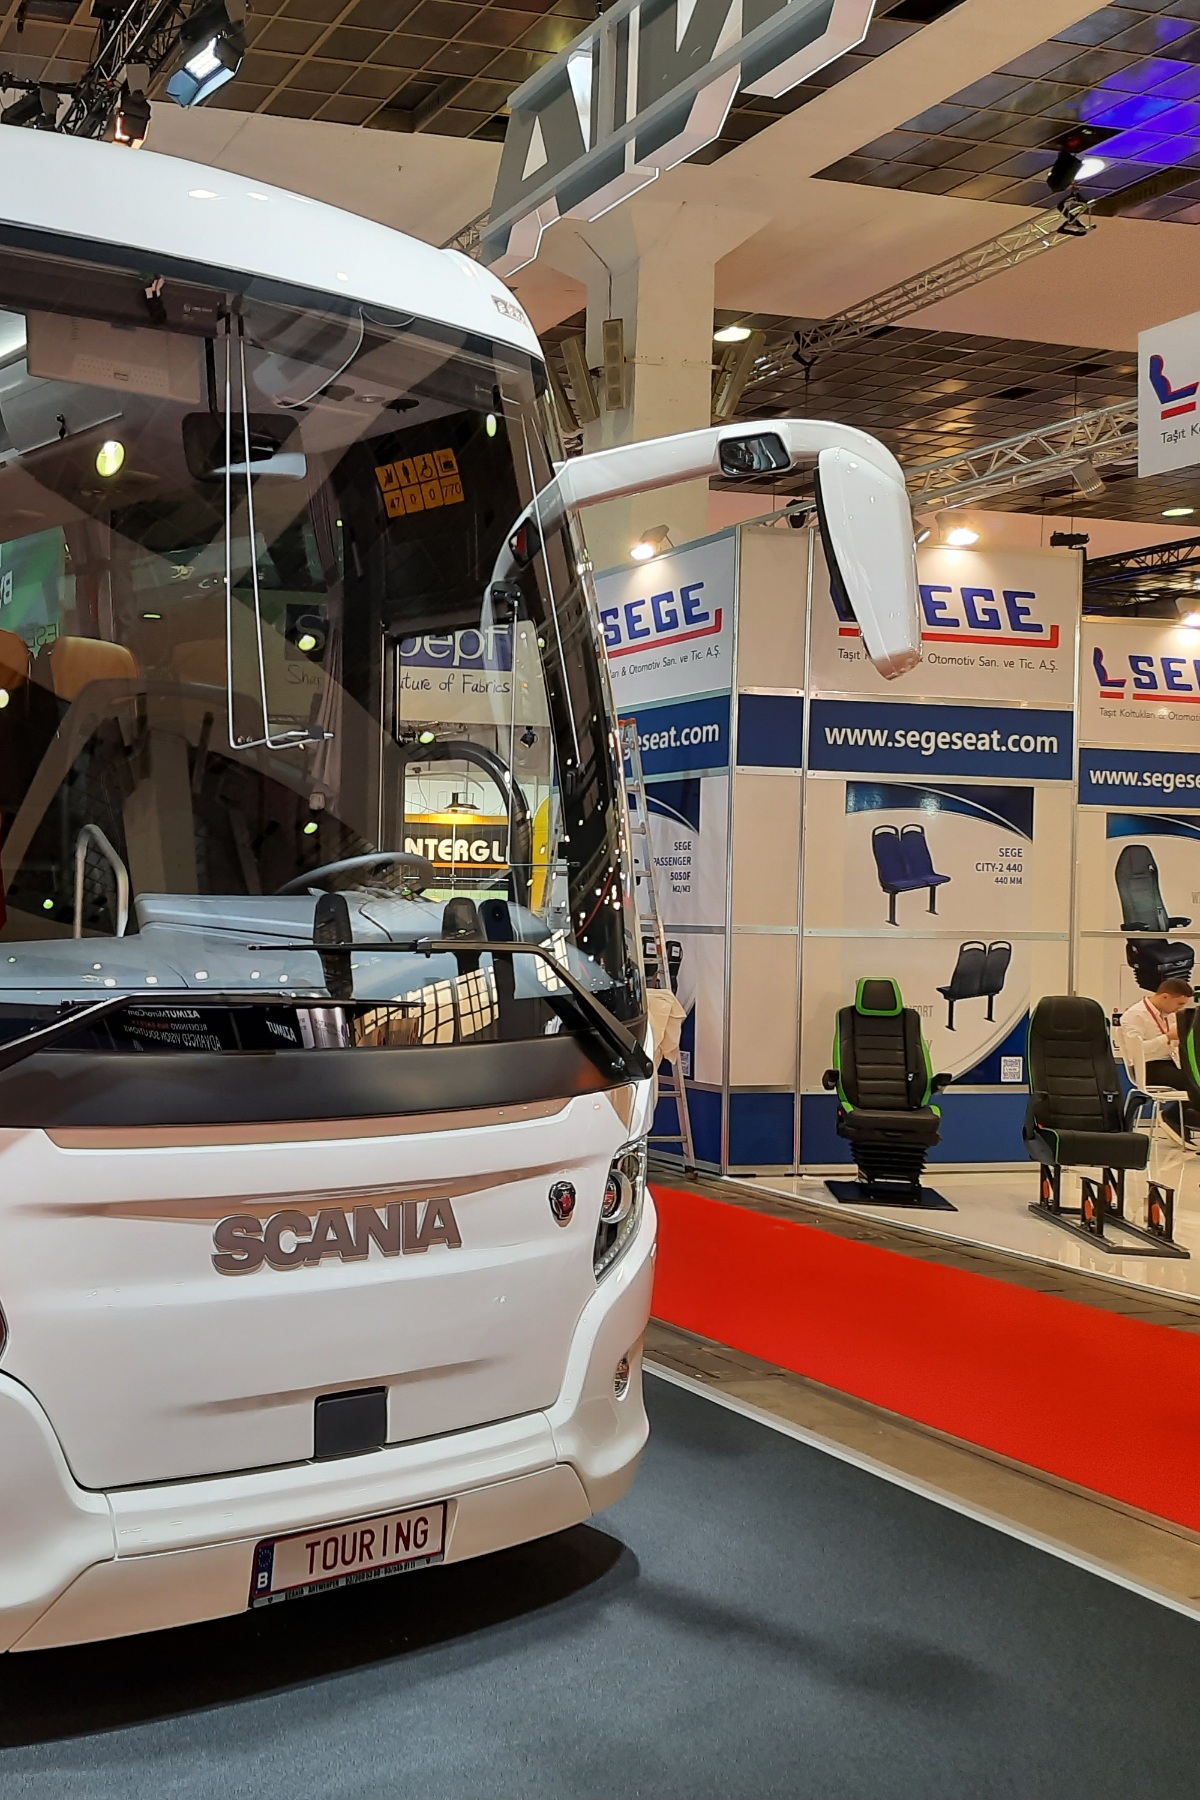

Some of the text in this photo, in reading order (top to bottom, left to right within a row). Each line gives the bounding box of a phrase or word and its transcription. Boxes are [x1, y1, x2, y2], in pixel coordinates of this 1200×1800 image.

[600, 582, 710, 647] SEGE
[629, 659, 661, 675] Otomotiv
[662, 656, 677, 668] San.
[680, 654, 689, 663] ve
[691, 649, 703, 661] Tic.
[838, 648, 860, 662] Taşıt
[928, 653, 1059, 673] Otomotiv San. ve Tic. A.Ş.
[439, 673, 455, 693] of
[462, 674, 511, 694] Fabrics
[824, 726, 1058, 755] www.segeseat.com
[674, 841, 692, 851] SEGE
[999, 848, 1023, 858] SEGE
[670, 871, 691, 881] 5050F
[975, 863, 1023, 873] CITY-2 440
[994, 877, 1023, 885] 440 MM
[211, 1197, 463, 1277] SCANIA
[305, 1516, 429, 1575] TOURING
[257, 1571, 268, 1588] B
